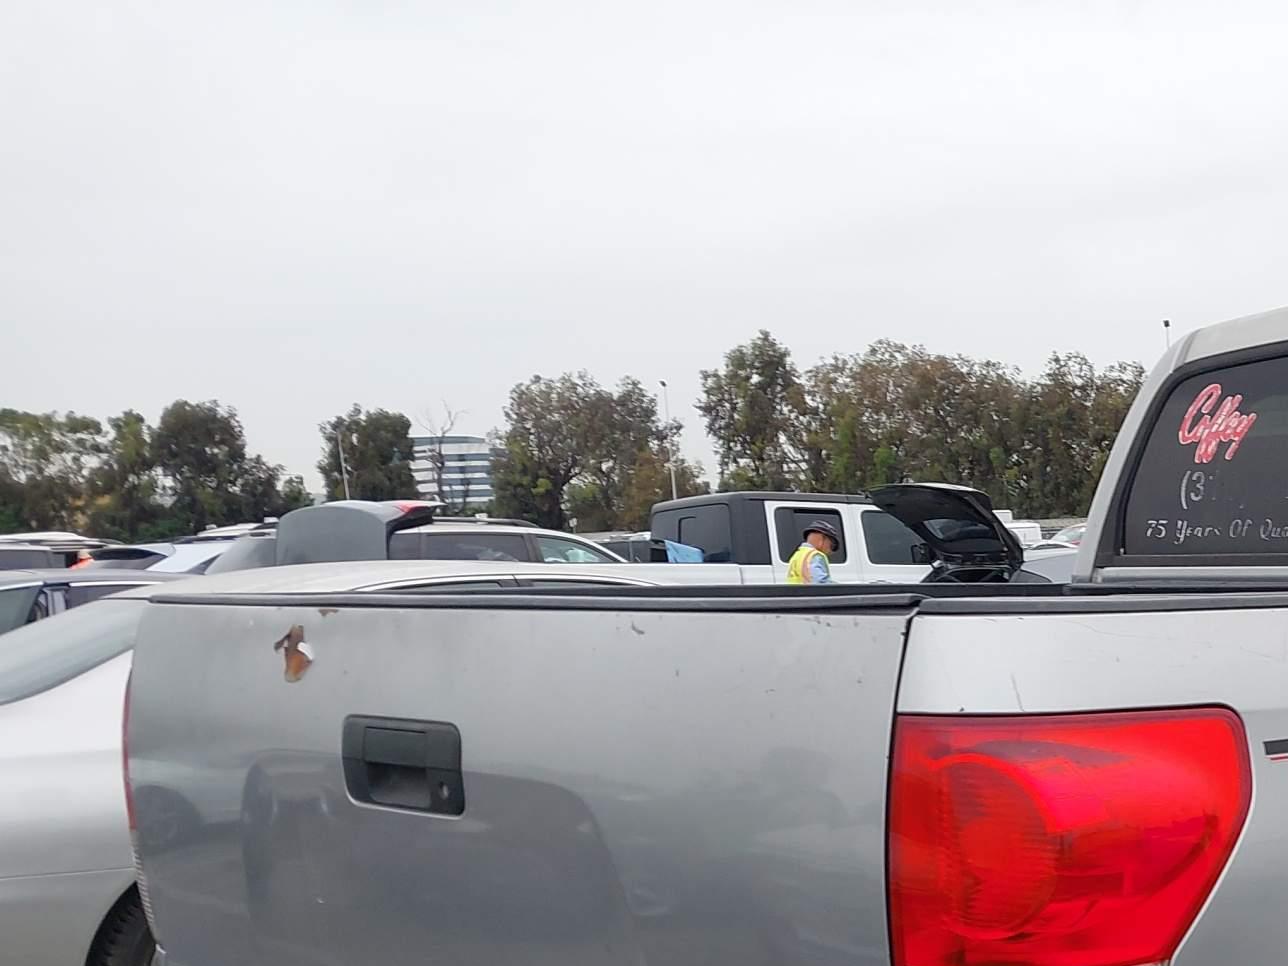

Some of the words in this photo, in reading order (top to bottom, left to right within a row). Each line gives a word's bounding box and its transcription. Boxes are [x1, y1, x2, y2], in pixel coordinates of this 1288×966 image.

[1145, 519, 1169, 538] 75
[1174, 519, 1222, 544] Years
[1229, 519, 1252, 539] Of
